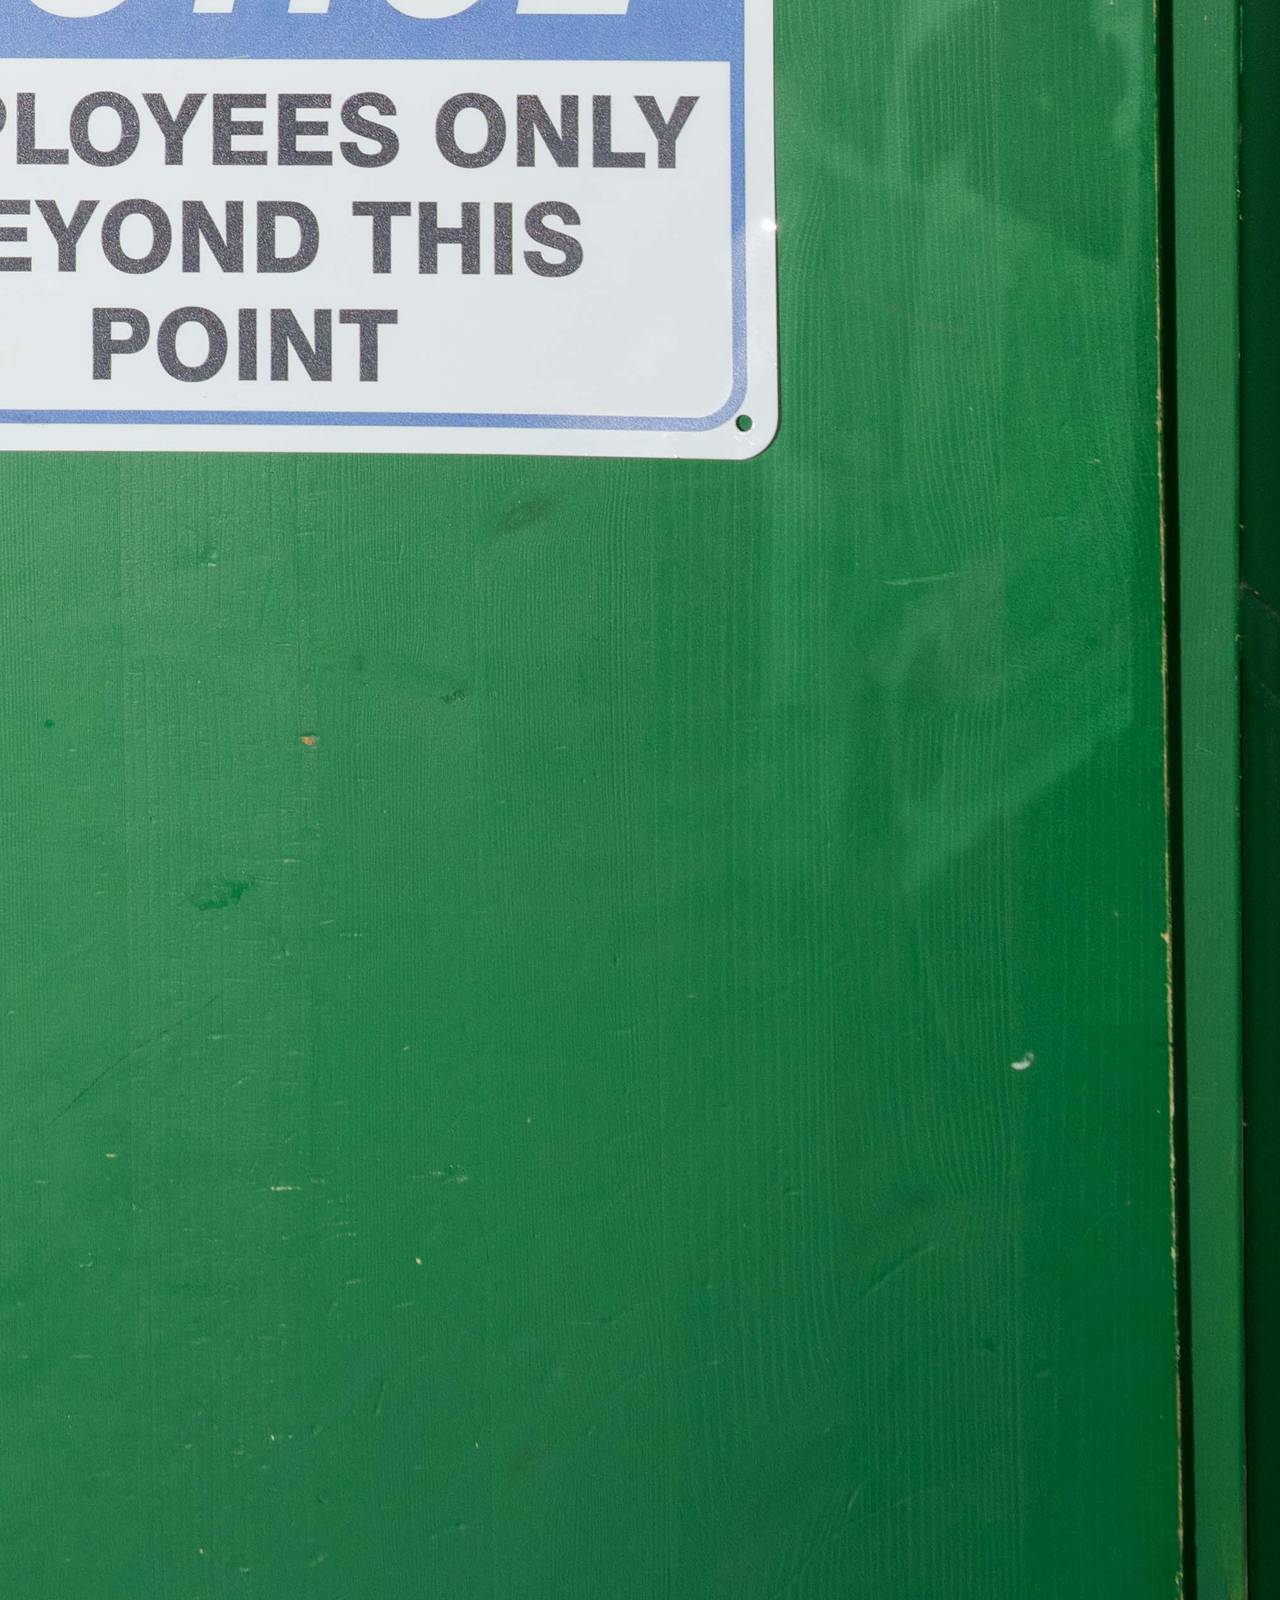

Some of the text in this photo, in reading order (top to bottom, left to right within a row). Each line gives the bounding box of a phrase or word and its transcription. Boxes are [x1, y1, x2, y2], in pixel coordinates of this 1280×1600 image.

[435, 93, 700, 169] ONLY
[352, 201, 584, 277] THIS
[92, 307, 398, 383] POINT
